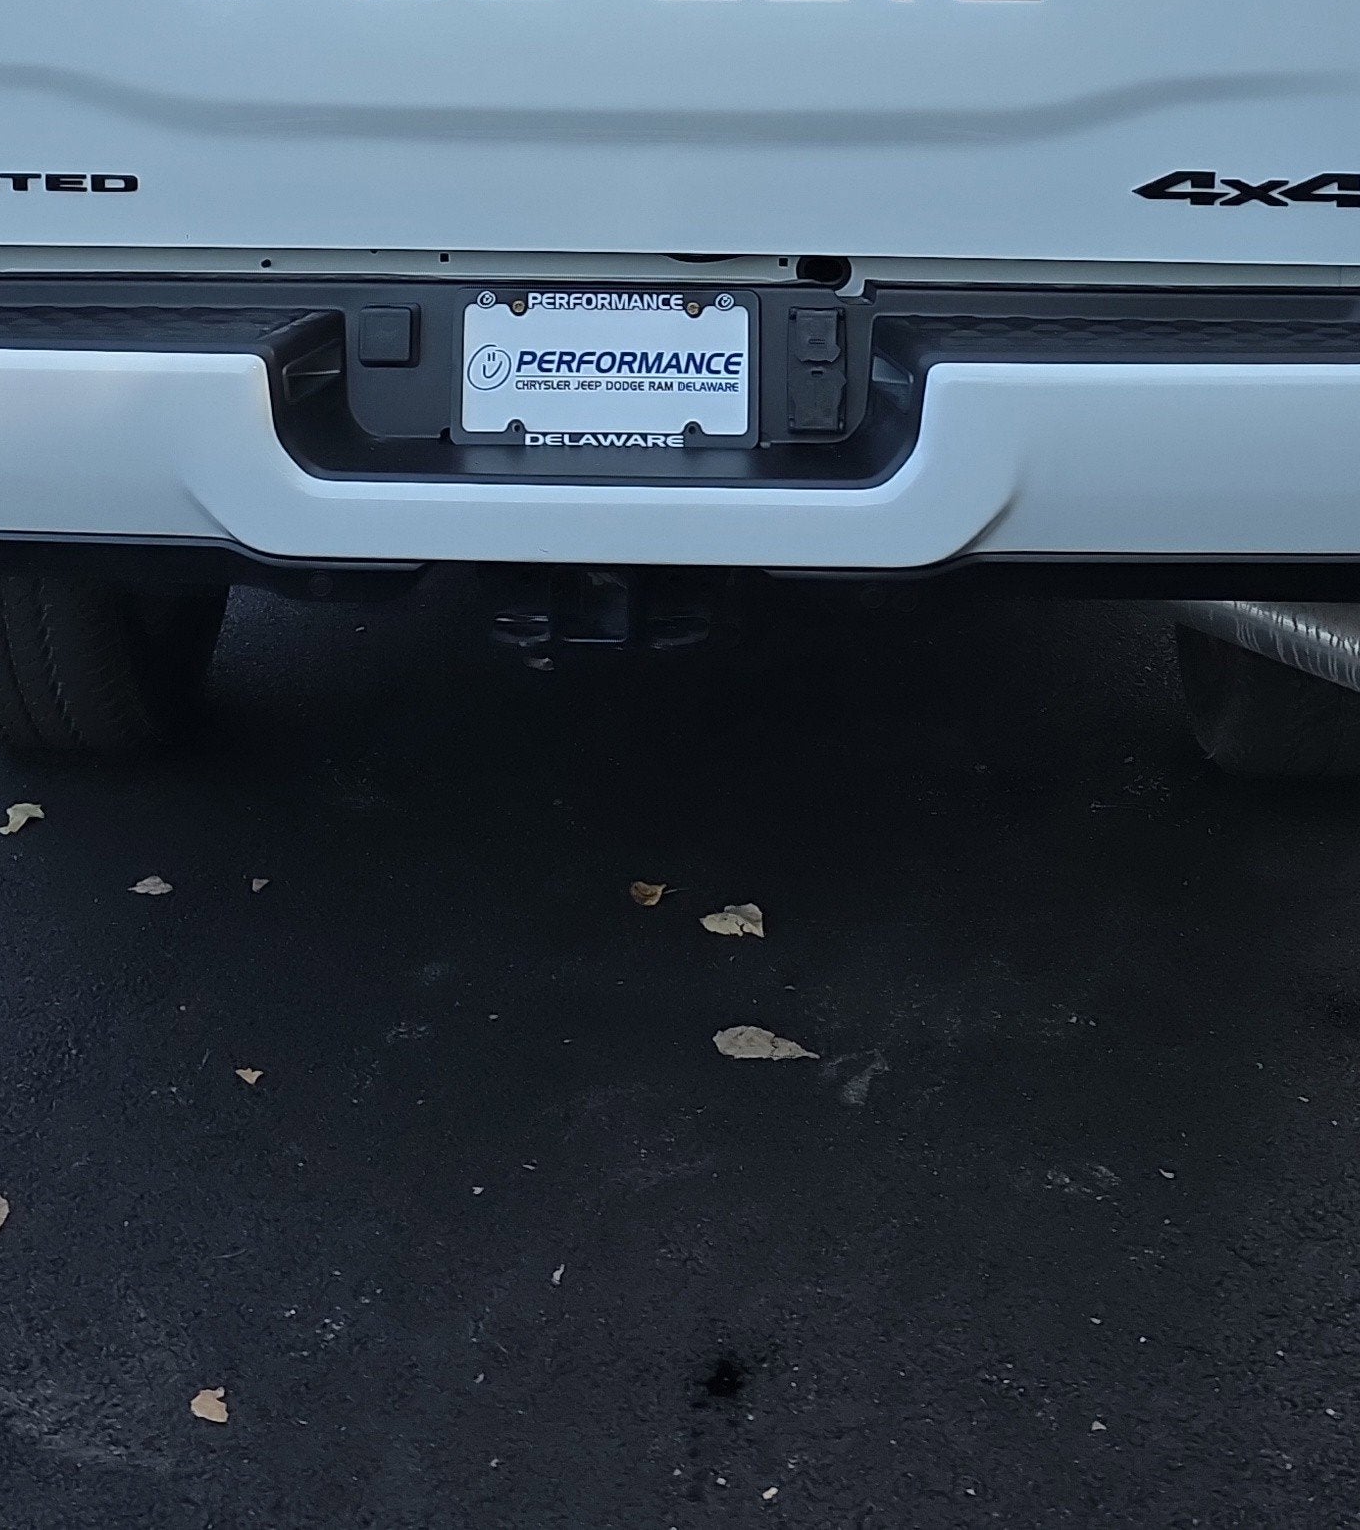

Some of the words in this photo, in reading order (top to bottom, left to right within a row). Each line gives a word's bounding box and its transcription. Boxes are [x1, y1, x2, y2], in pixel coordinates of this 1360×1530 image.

[527, 292, 684, 311] PERFORMANCE
[516, 350, 744, 375] PERFORMANCE
[515, 380, 571, 391] CHRYSLER
[574, 380, 603, 391] JEEP
[605, 380, 645, 391] DODGE
[648, 381, 674, 392] RAM
[678, 381, 739, 392] DELAWARE
[525, 433, 685, 448] DELAWARE
